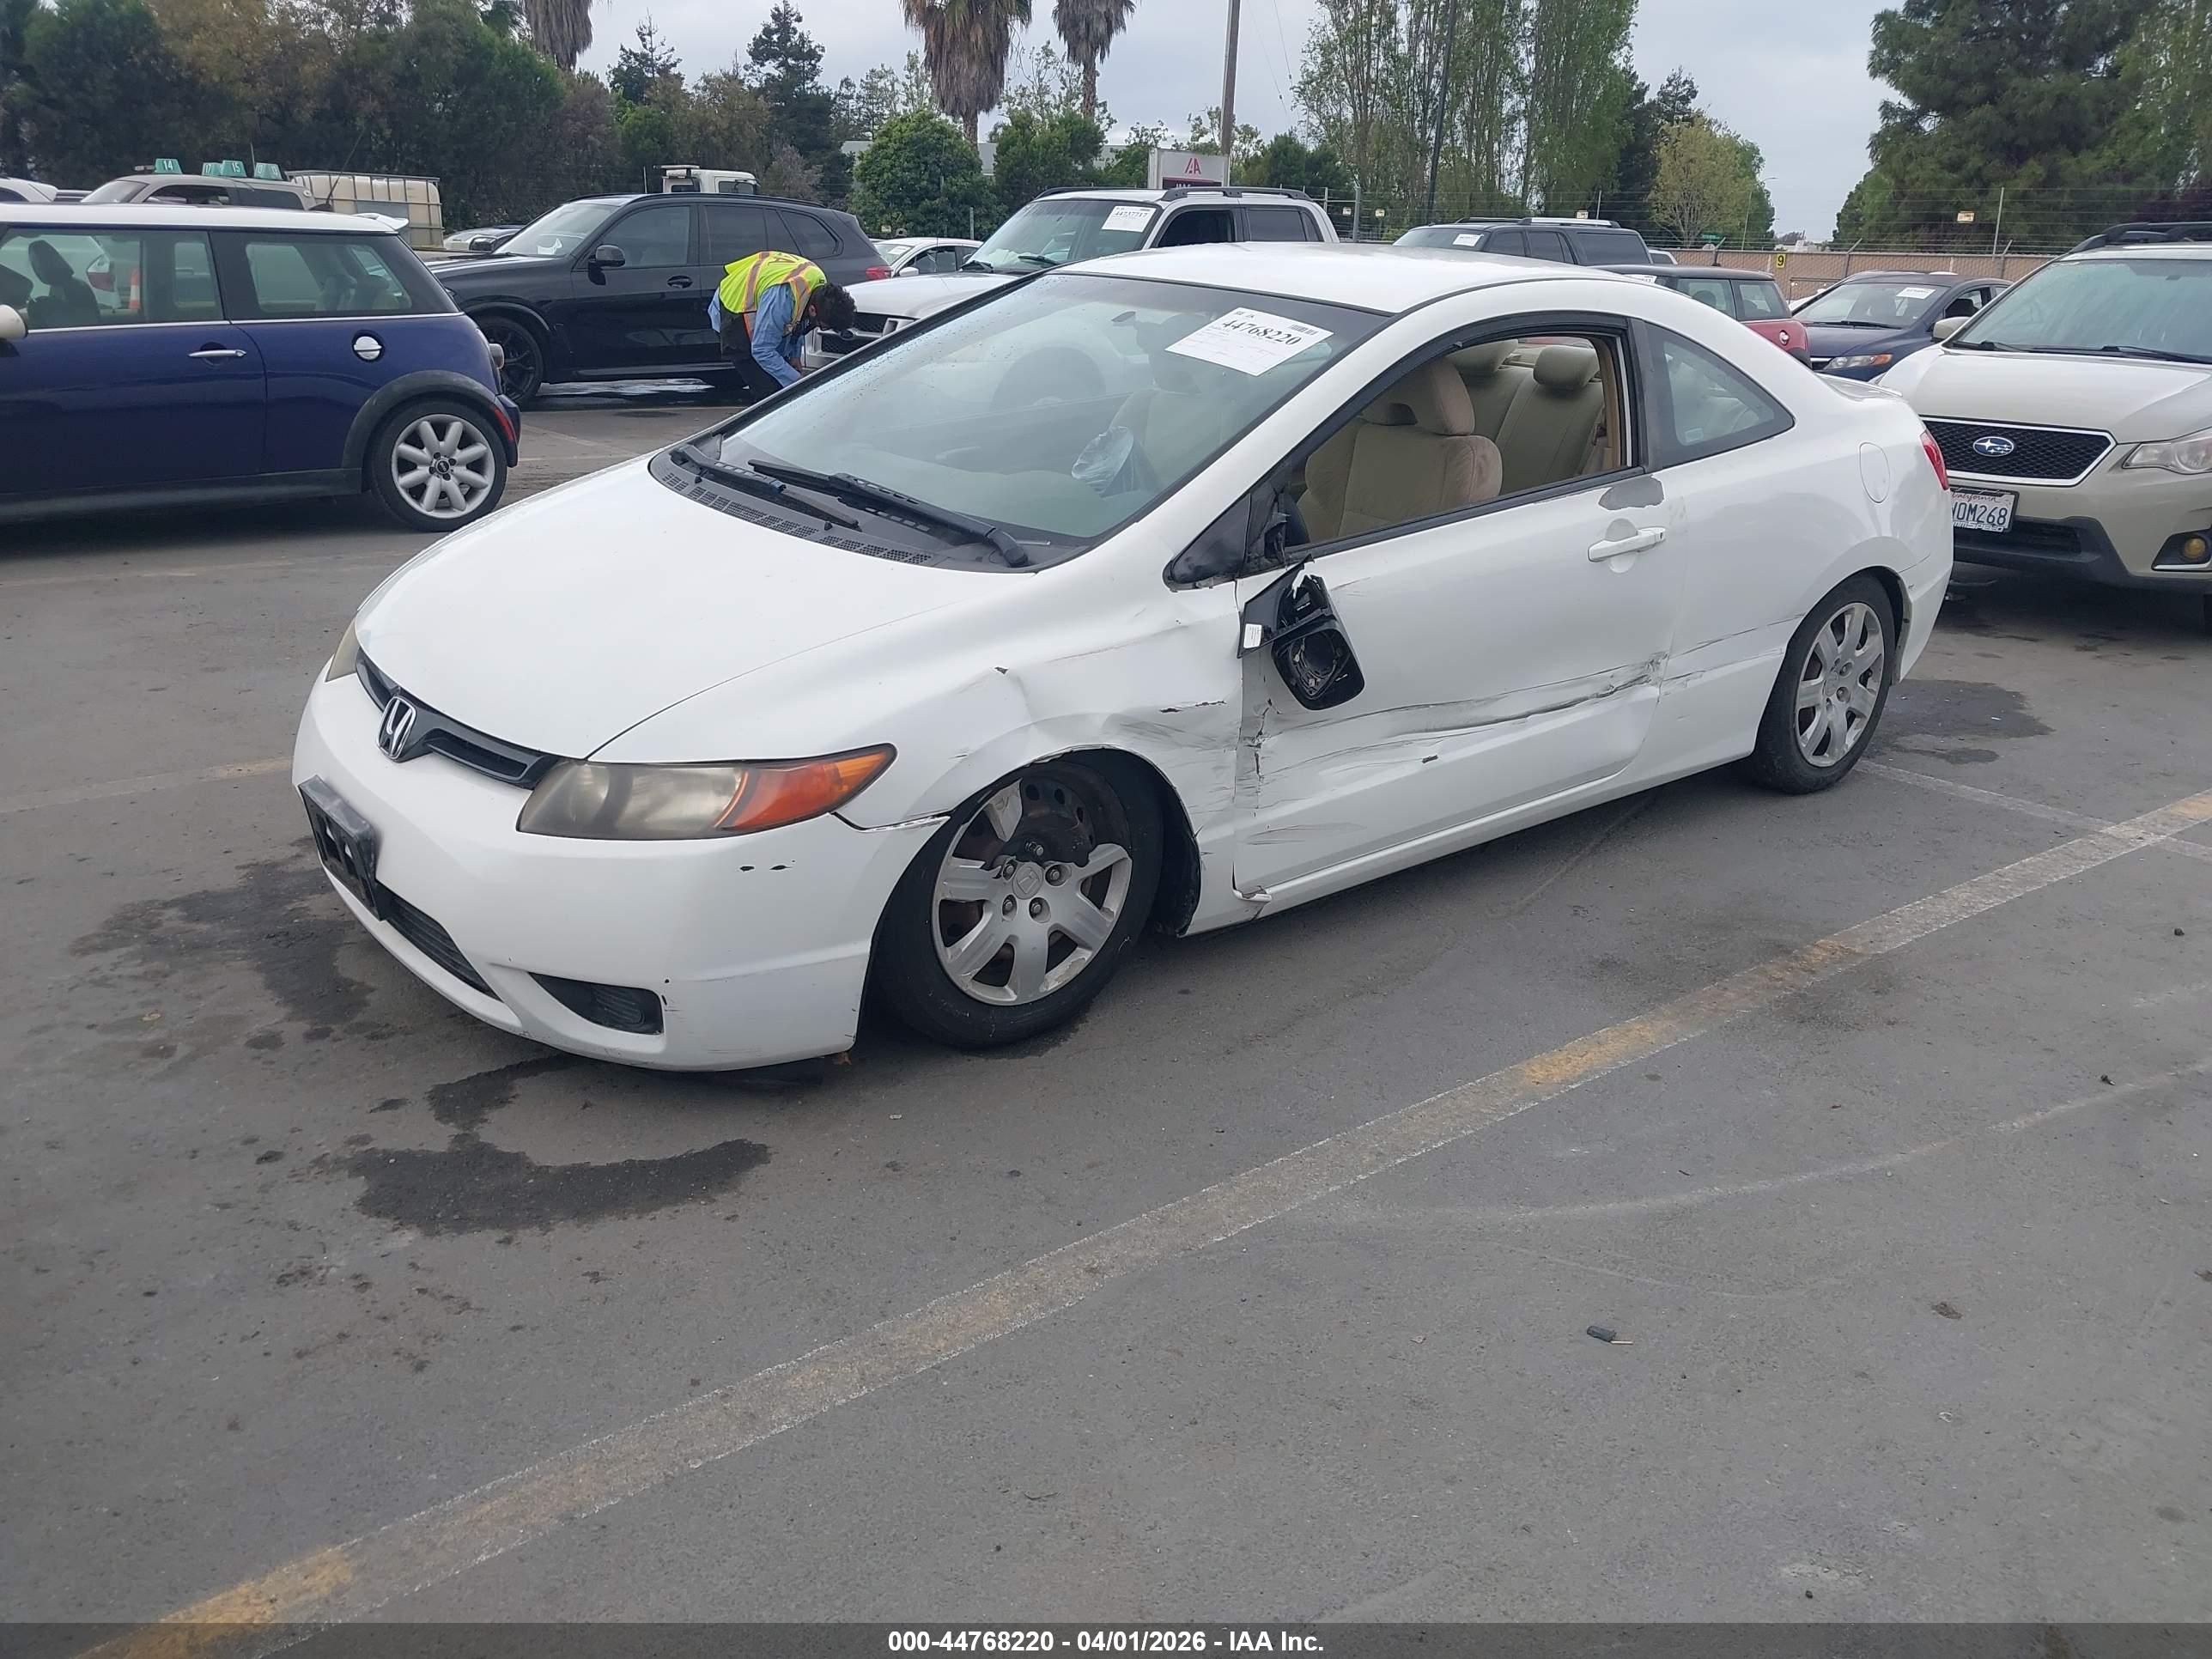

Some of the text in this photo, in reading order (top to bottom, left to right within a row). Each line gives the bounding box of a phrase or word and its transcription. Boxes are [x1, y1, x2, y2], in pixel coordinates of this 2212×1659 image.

[163, 160, 173, 171] 14
[232, 162, 240, 173] 15
[1778, 255, 1784, 266] 9
[1222, 319, 1302, 346] 44768220
